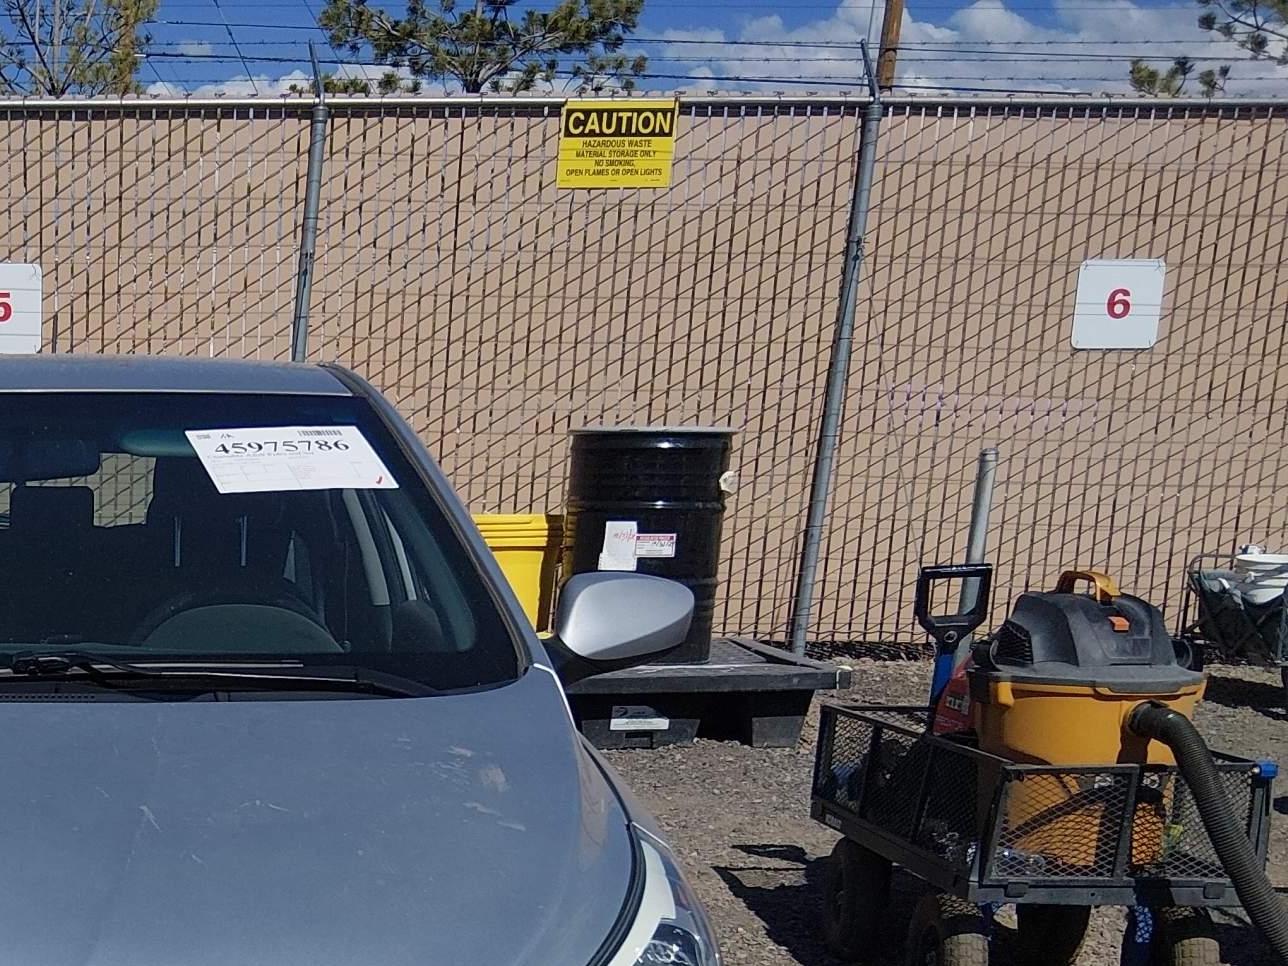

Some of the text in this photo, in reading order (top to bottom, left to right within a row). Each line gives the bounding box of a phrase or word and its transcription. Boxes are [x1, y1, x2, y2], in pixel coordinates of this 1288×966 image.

[568, 111, 672, 135] CAUTION
[582, 139, 653, 148] HAZARDOUS WASTE
[575, 150, 657, 158] MATERIAL STORAGE ONLY
[621, 168, 639, 176] OPEN
[639, 168, 663, 176] LIGHTS
[1106, 288, 1131, 319] 6
[214, 440, 350, 455] 45975786
